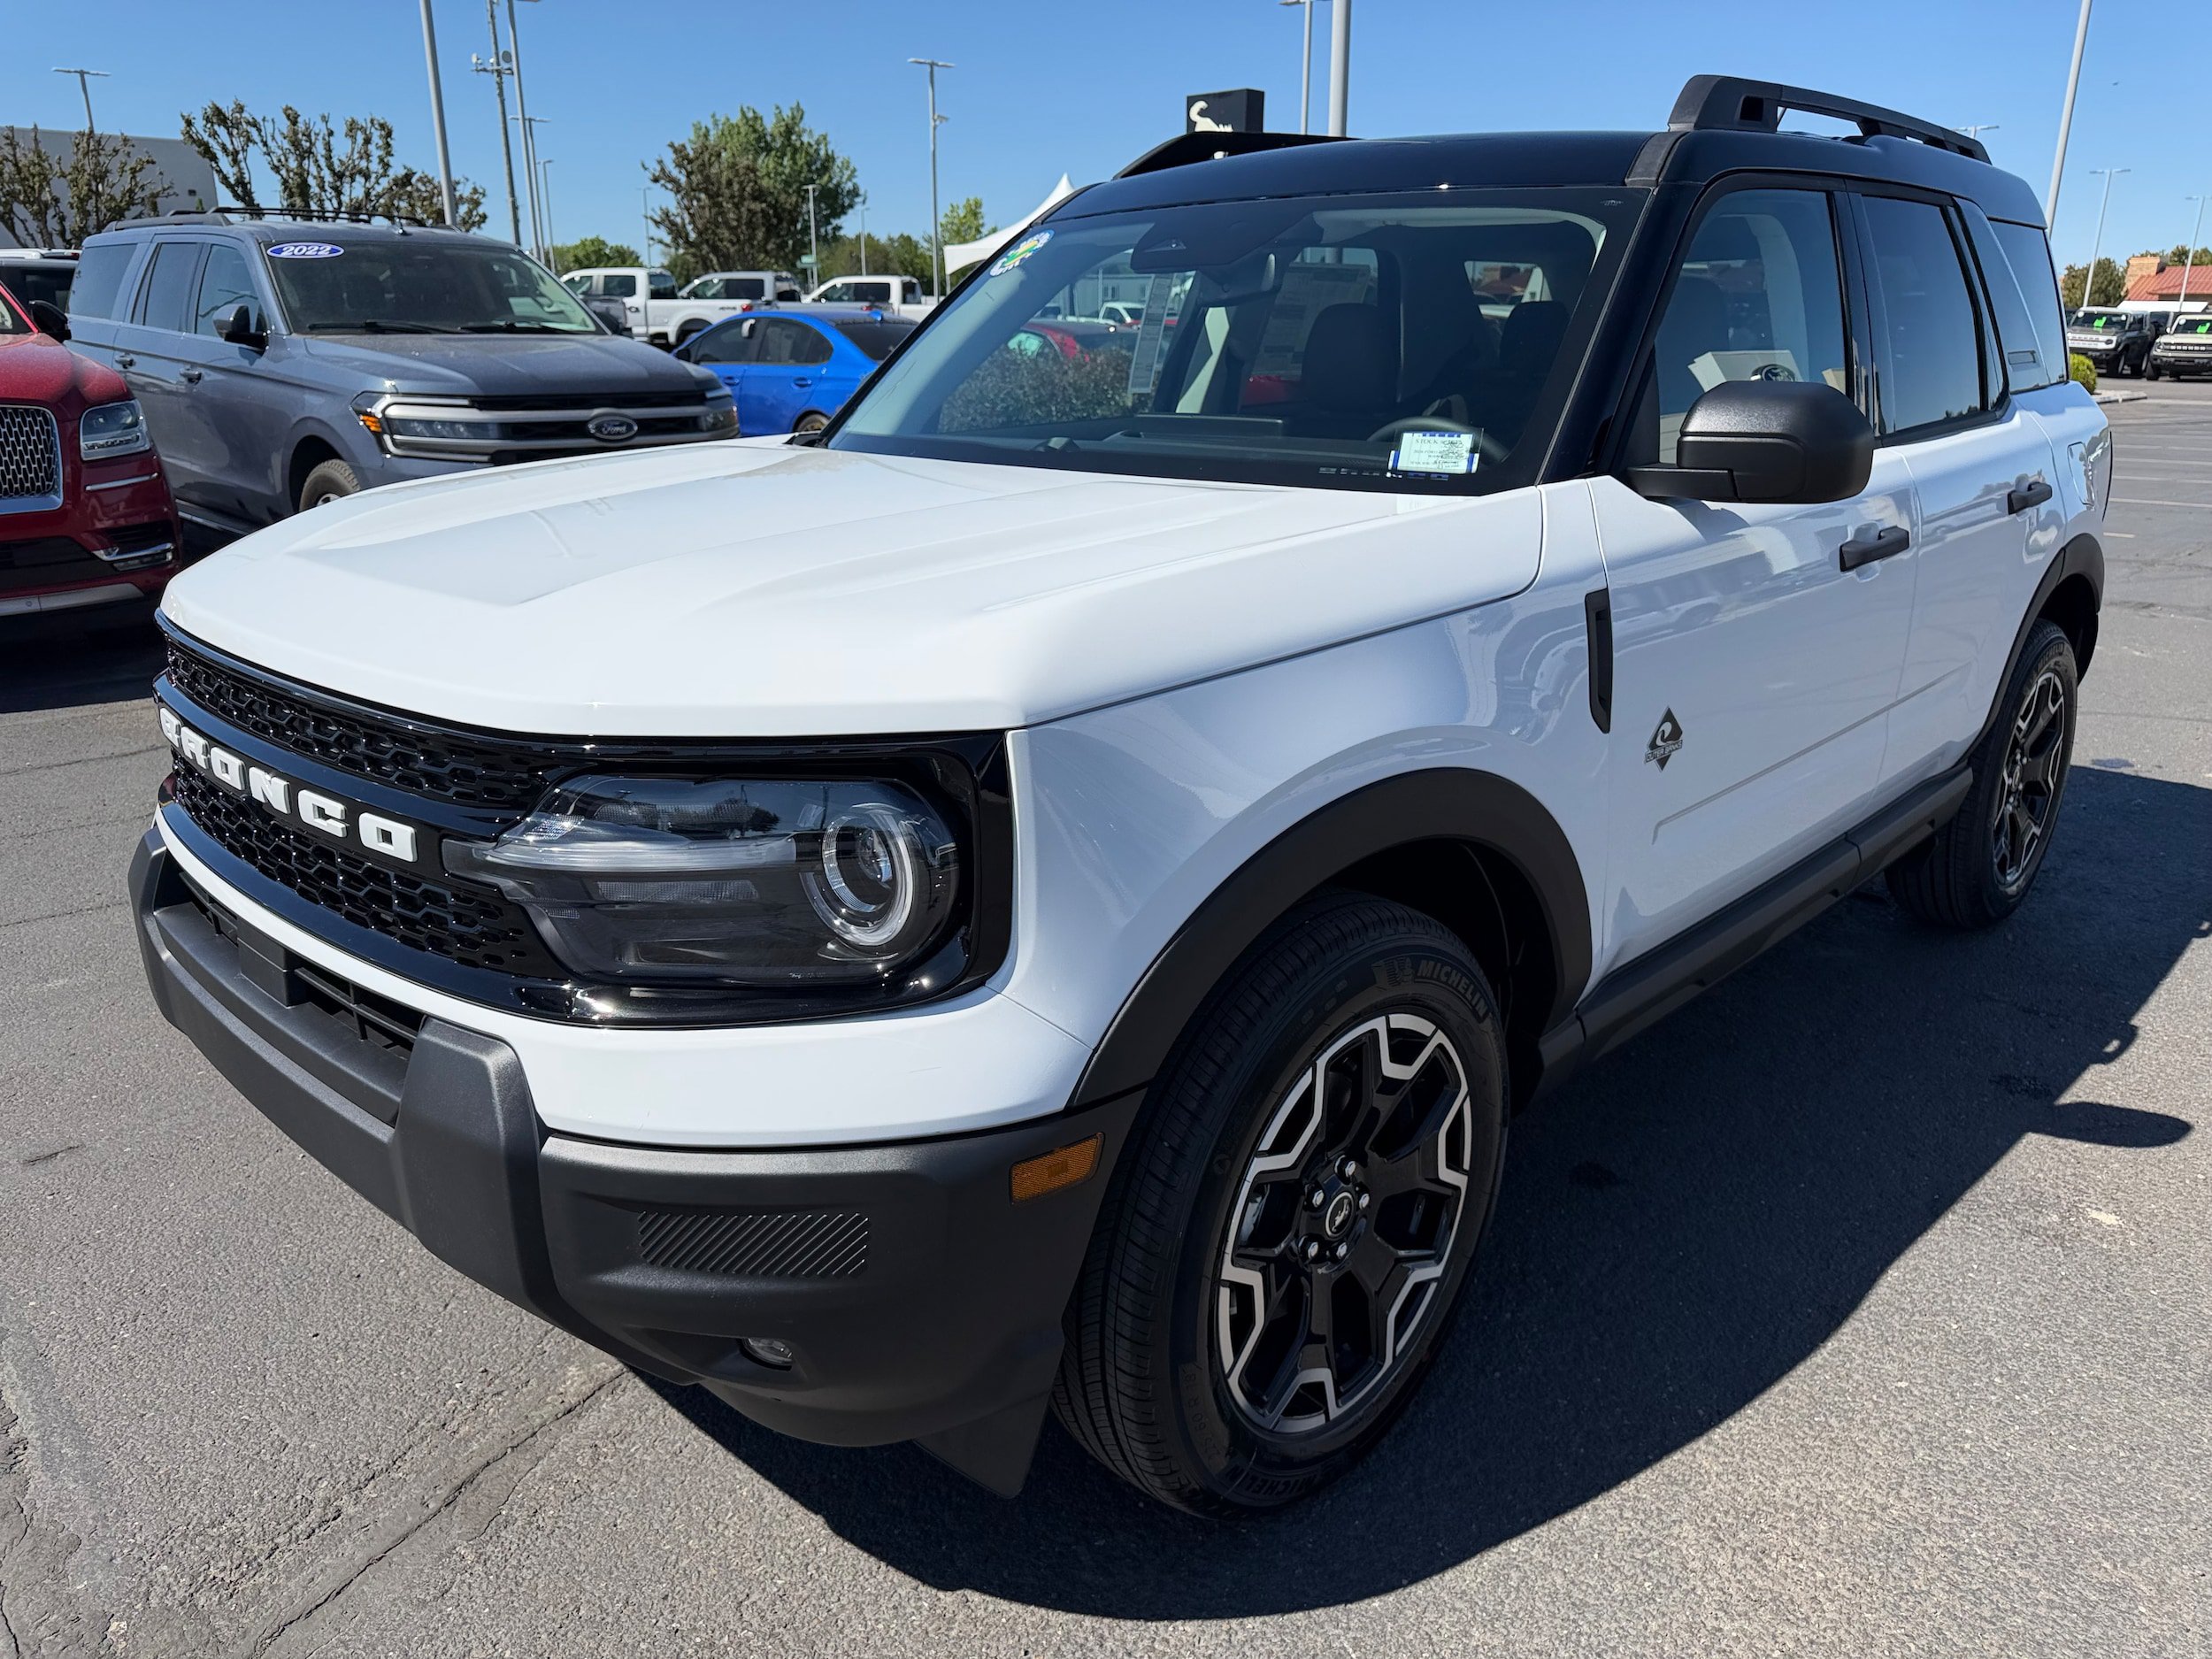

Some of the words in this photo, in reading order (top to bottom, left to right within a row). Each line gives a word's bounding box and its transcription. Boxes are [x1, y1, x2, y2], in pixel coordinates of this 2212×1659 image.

[280, 245, 332, 257] 2022
[601, 420, 627, 434] Ford
[1646, 748, 1664, 762] OUTER
[160, 708, 419, 863] BRONCO
[1417, 959, 1490, 1017] MICHELIN
